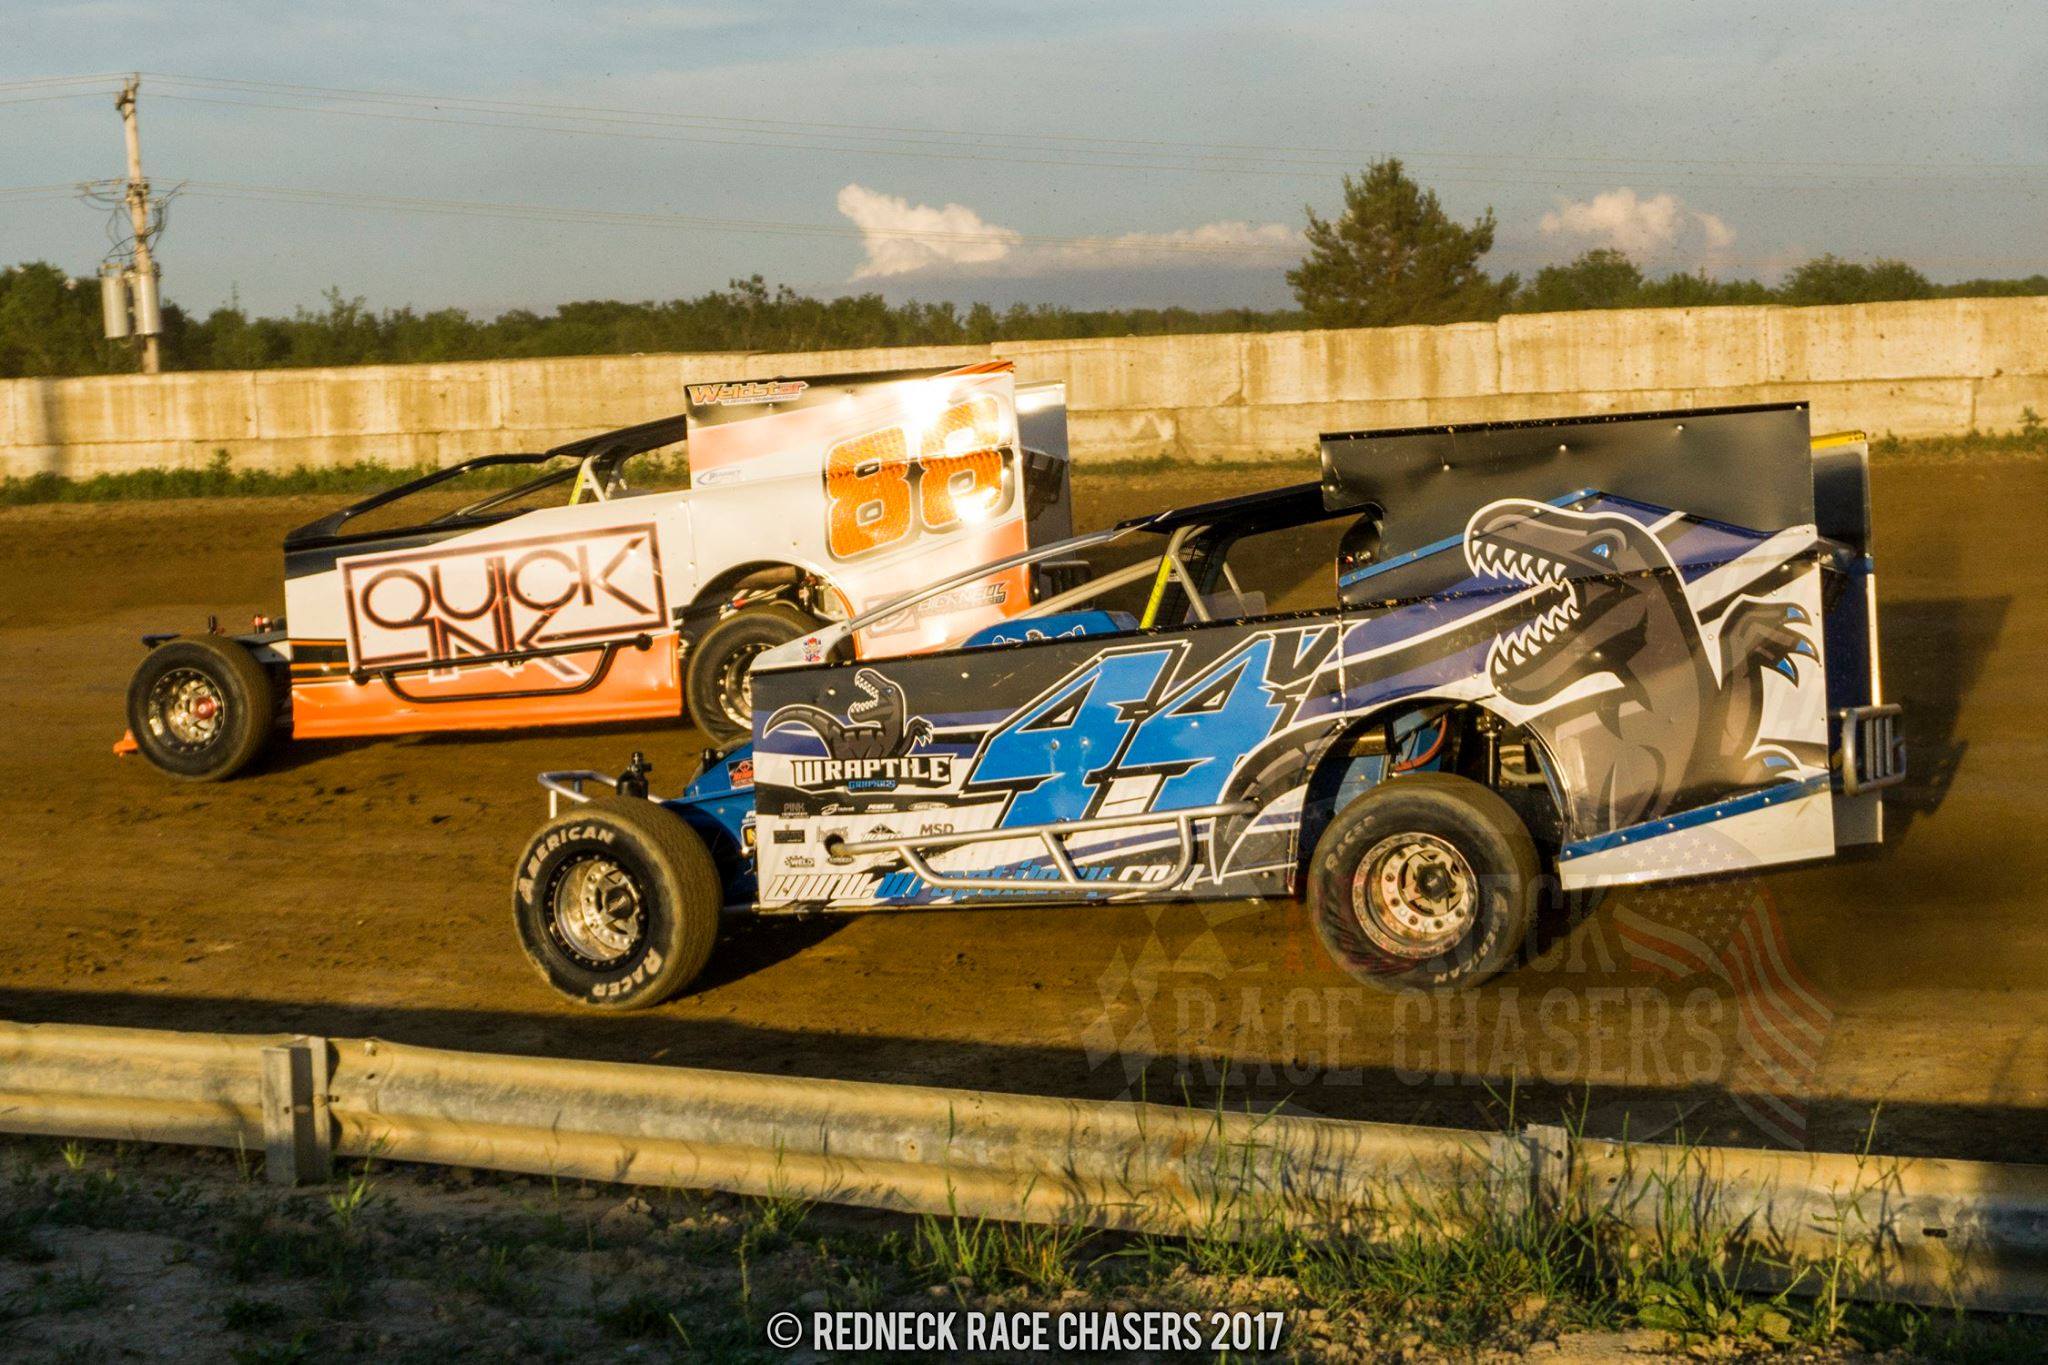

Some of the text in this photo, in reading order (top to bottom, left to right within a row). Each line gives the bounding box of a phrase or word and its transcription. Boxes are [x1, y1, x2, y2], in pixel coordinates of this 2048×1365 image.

[690, 382, 807, 404] Weldstar
[824, 391, 1002, 559] 88
[361, 535, 657, 629] QUICK
[793, 756, 951, 785] WRAPTILE
[920, 823, 954, 835] MSD
[518, 825, 615, 906] AMERICAN
[592, 947, 663, 998] RACER
